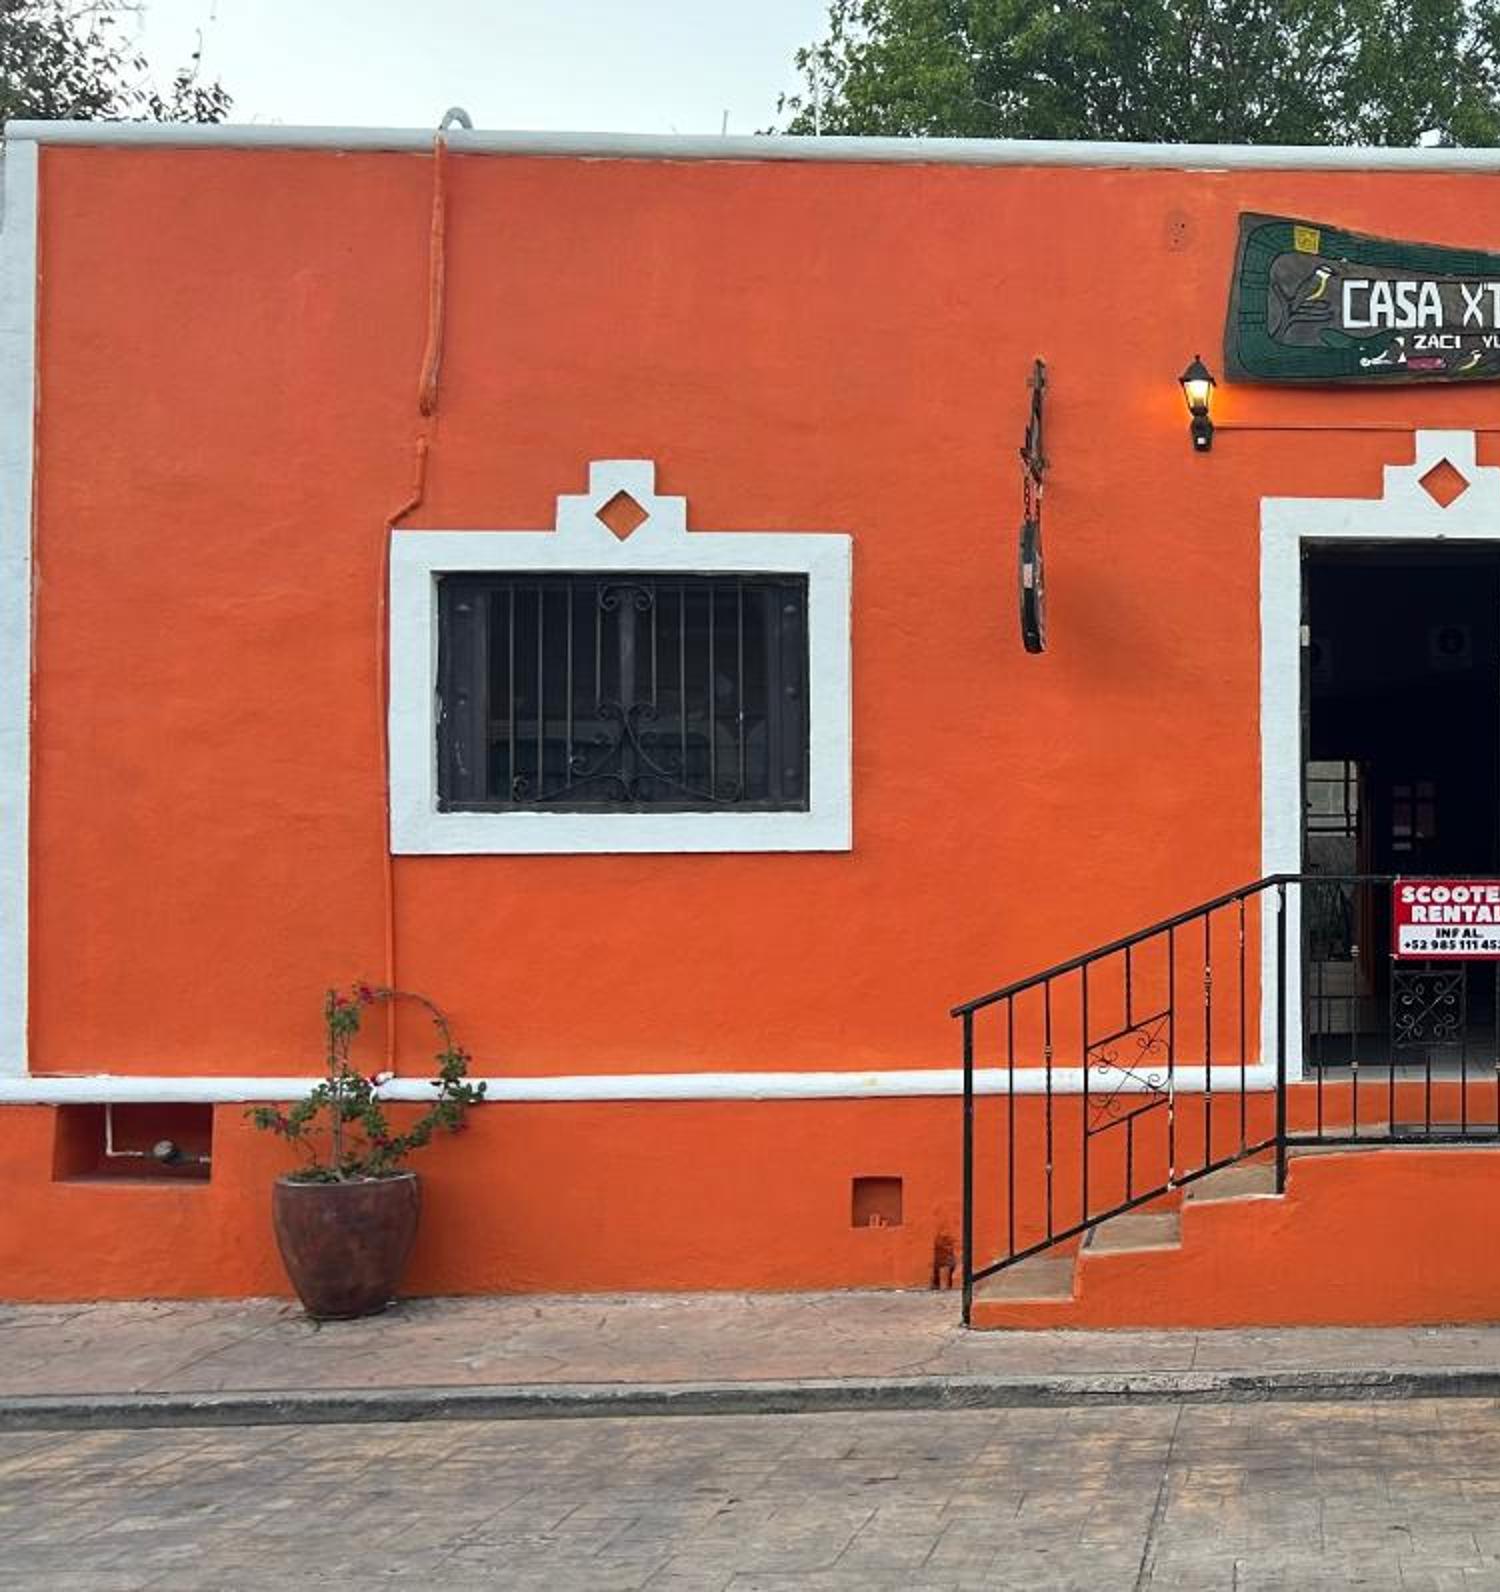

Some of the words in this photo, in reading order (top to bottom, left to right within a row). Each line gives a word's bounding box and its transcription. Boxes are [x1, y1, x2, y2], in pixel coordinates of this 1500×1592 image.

[1342, 280, 1443, 329] CASA
[1413, 335, 1461, 350] ZACI
[1435, 928, 1459, 938] INF
[1404, 940, 1428, 950] +52
[1431, 940, 1457, 950] 985
[1459, 940, 1479, 950] 111
